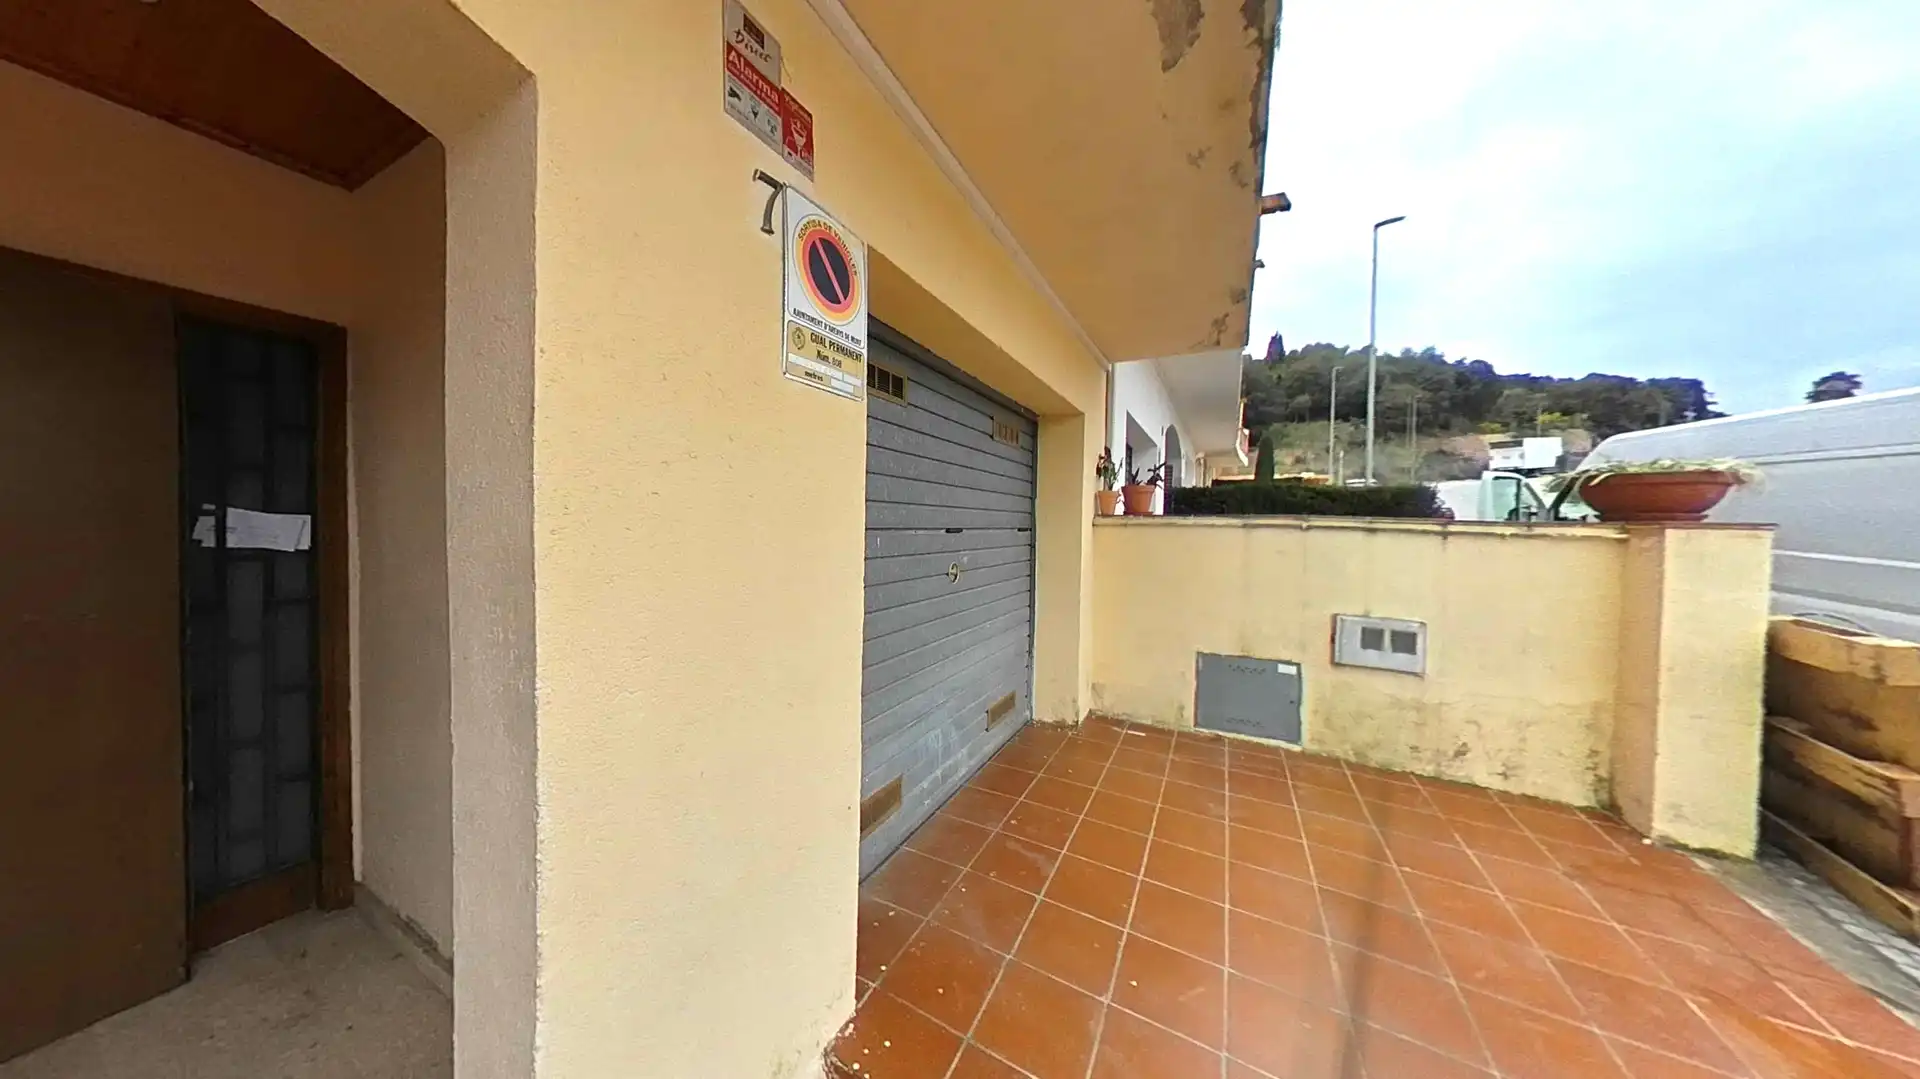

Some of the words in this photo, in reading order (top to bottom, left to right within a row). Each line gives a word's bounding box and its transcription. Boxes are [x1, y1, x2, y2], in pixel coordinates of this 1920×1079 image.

[728, 50, 779, 104] Alarma
[752, 168, 783, 235] 7
[810, 332, 828, 348] GUAL
[829, 339, 862, 363] PERMANENT
